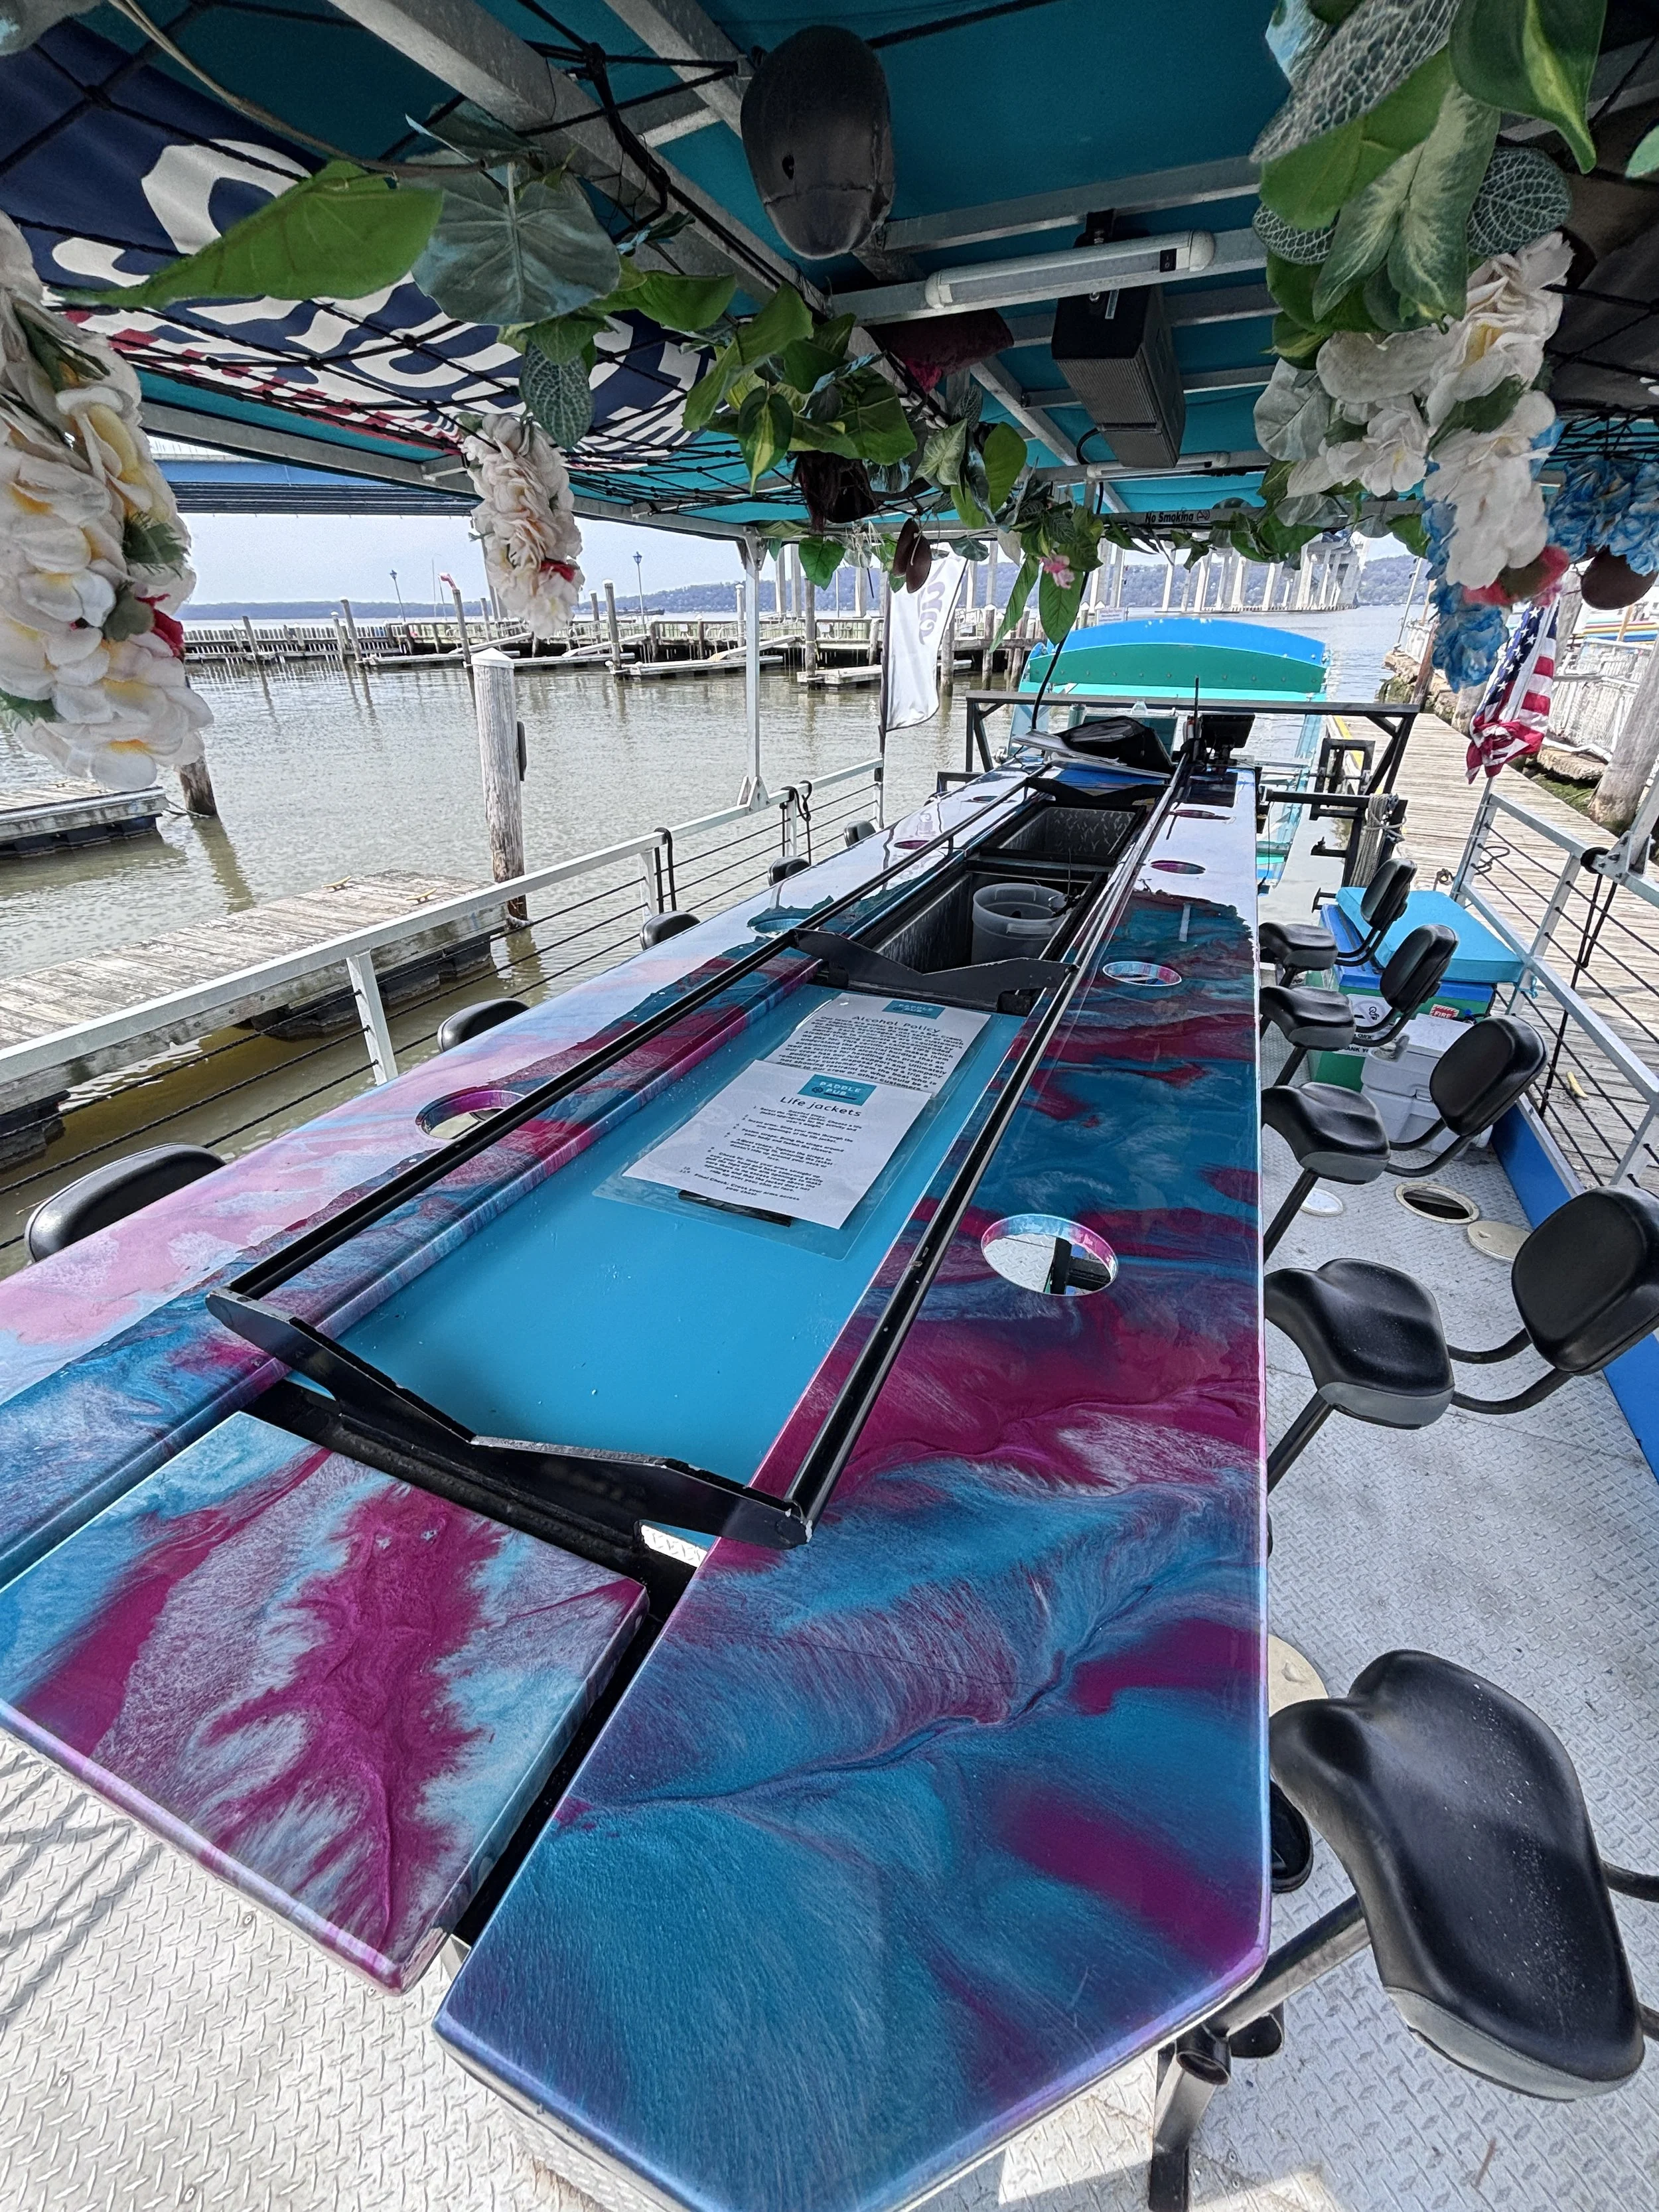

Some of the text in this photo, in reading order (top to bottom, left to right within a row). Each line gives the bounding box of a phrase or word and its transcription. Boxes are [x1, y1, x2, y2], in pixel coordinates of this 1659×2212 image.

[1145, 512, 1156, 522] No
[852, 1016, 940, 1033] Alcohol Policy
[820, 1081, 861, 1092] PADDLE
[780, 1096, 862, 1117] Life jackets
